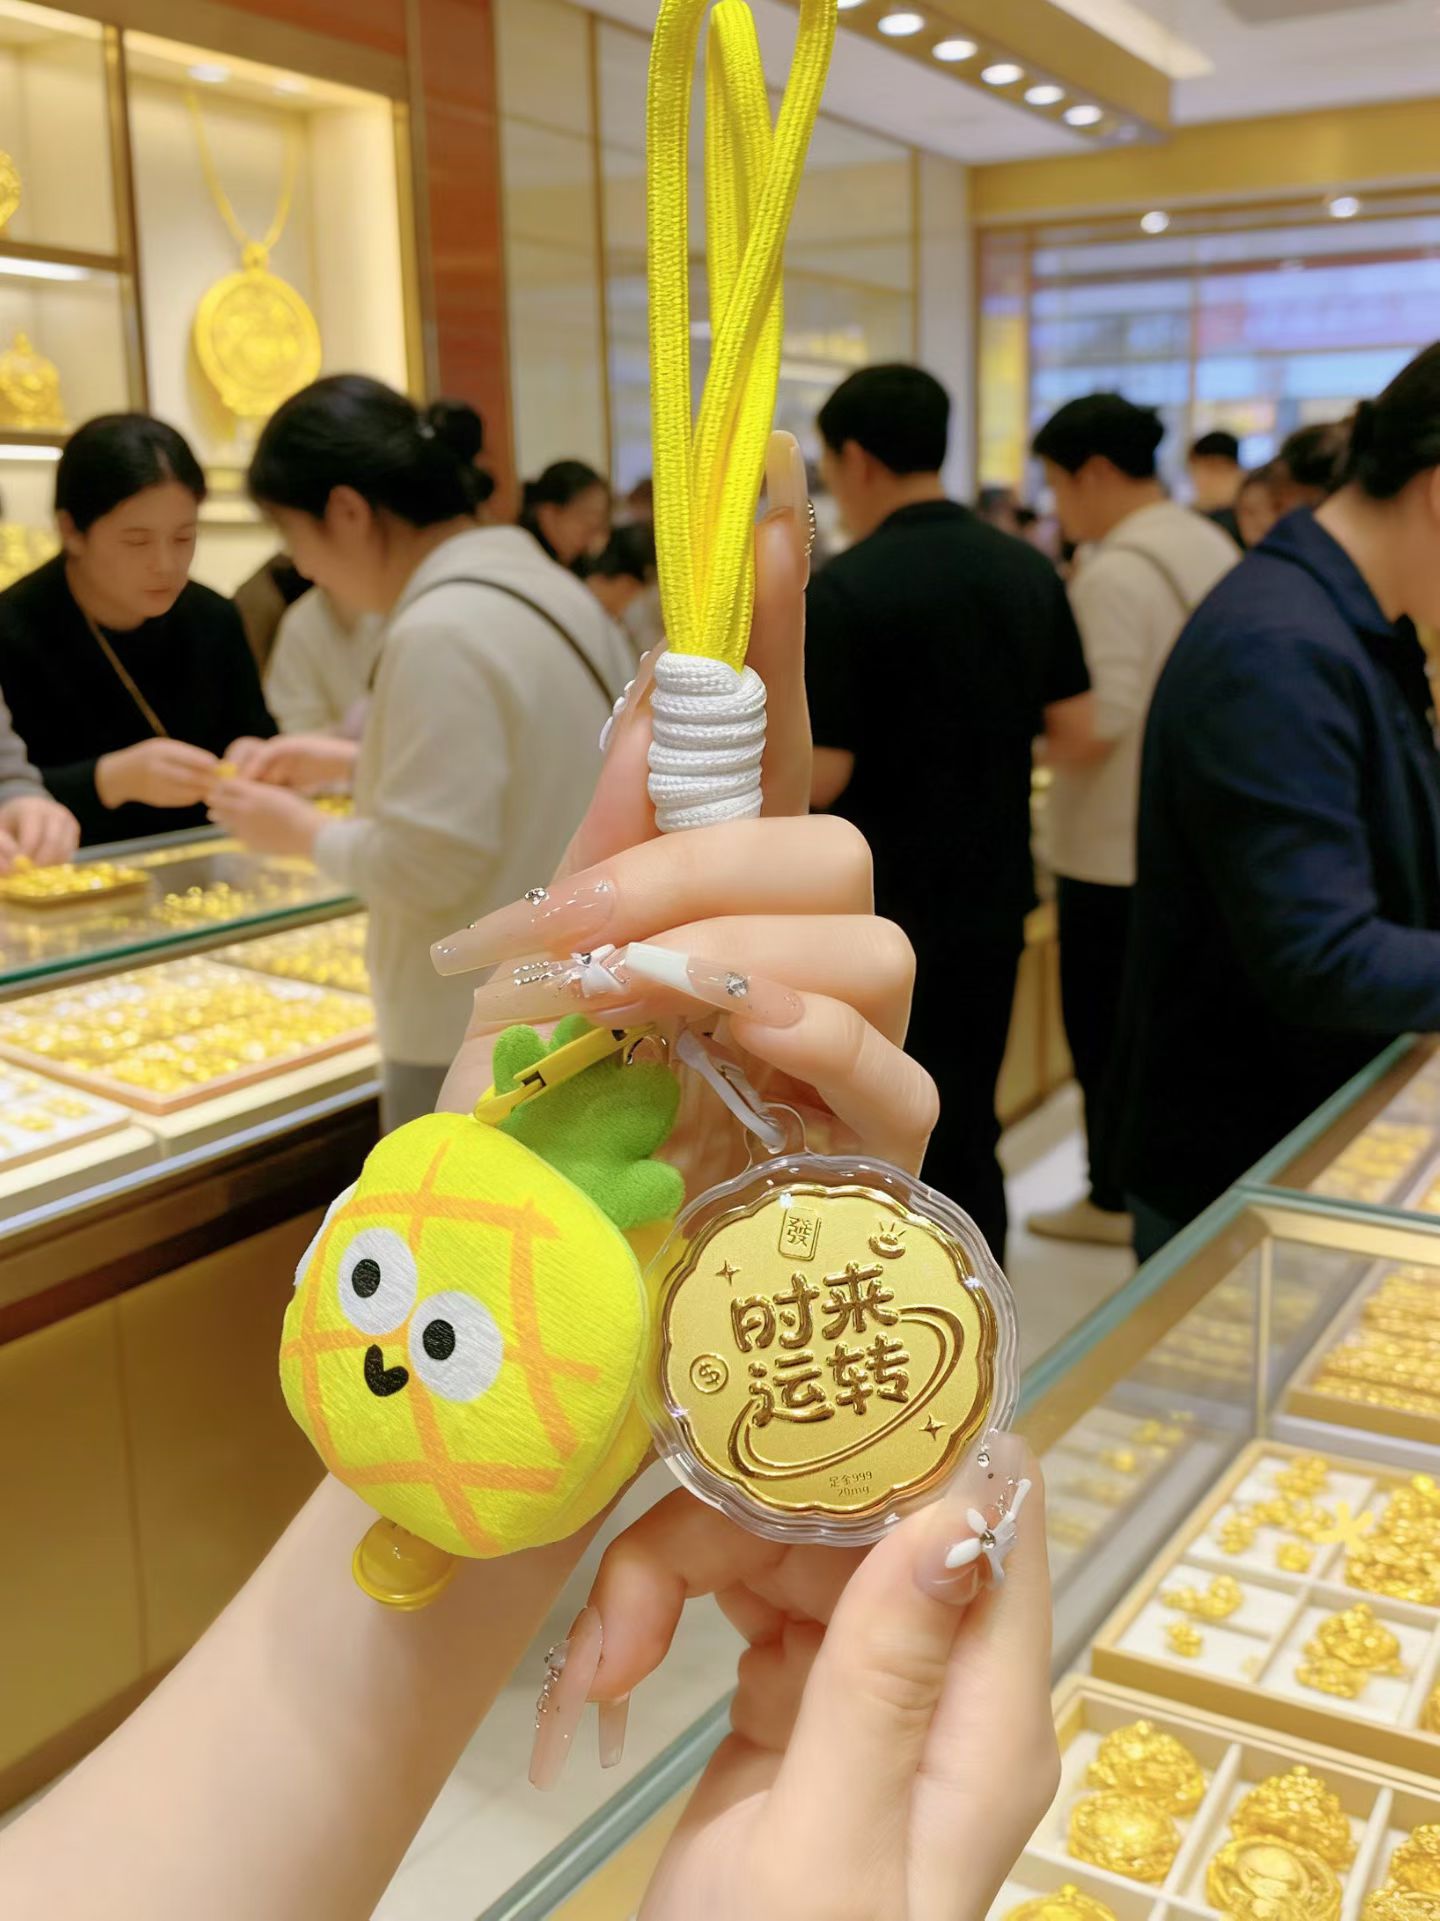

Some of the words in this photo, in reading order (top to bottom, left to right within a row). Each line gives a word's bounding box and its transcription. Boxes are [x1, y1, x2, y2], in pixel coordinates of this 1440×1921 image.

[787, 1215, 813, 1247] 發
[731, 1260, 899, 1352] 时来
[748, 1331, 910, 1427] 运转
